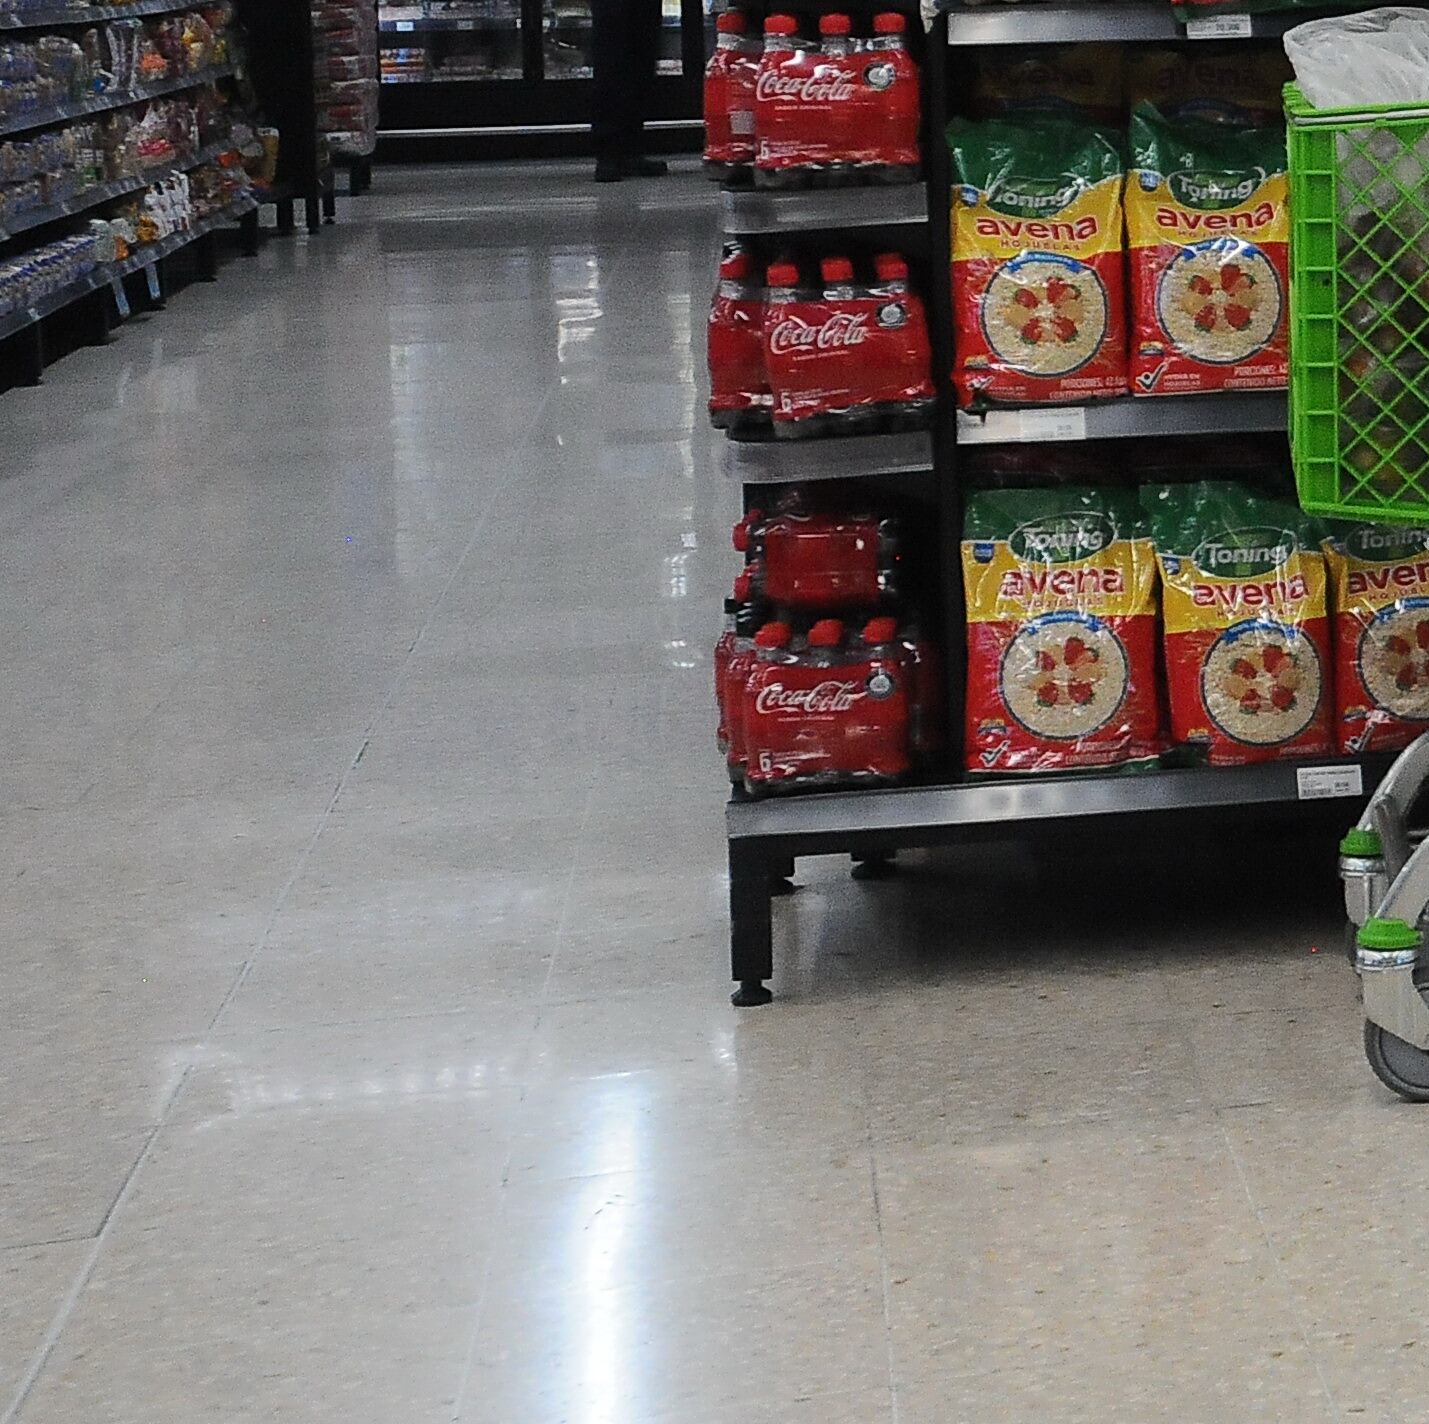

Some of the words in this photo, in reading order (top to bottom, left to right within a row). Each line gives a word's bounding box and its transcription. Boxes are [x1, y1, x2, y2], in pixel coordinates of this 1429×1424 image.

[976, 215, 1099, 241] avena
[1155, 201, 1276, 230] avena
[1204, 542, 1289, 566] Toning
[1000, 566, 1125, 598] avena
[1191, 573, 1310, 607] avena
